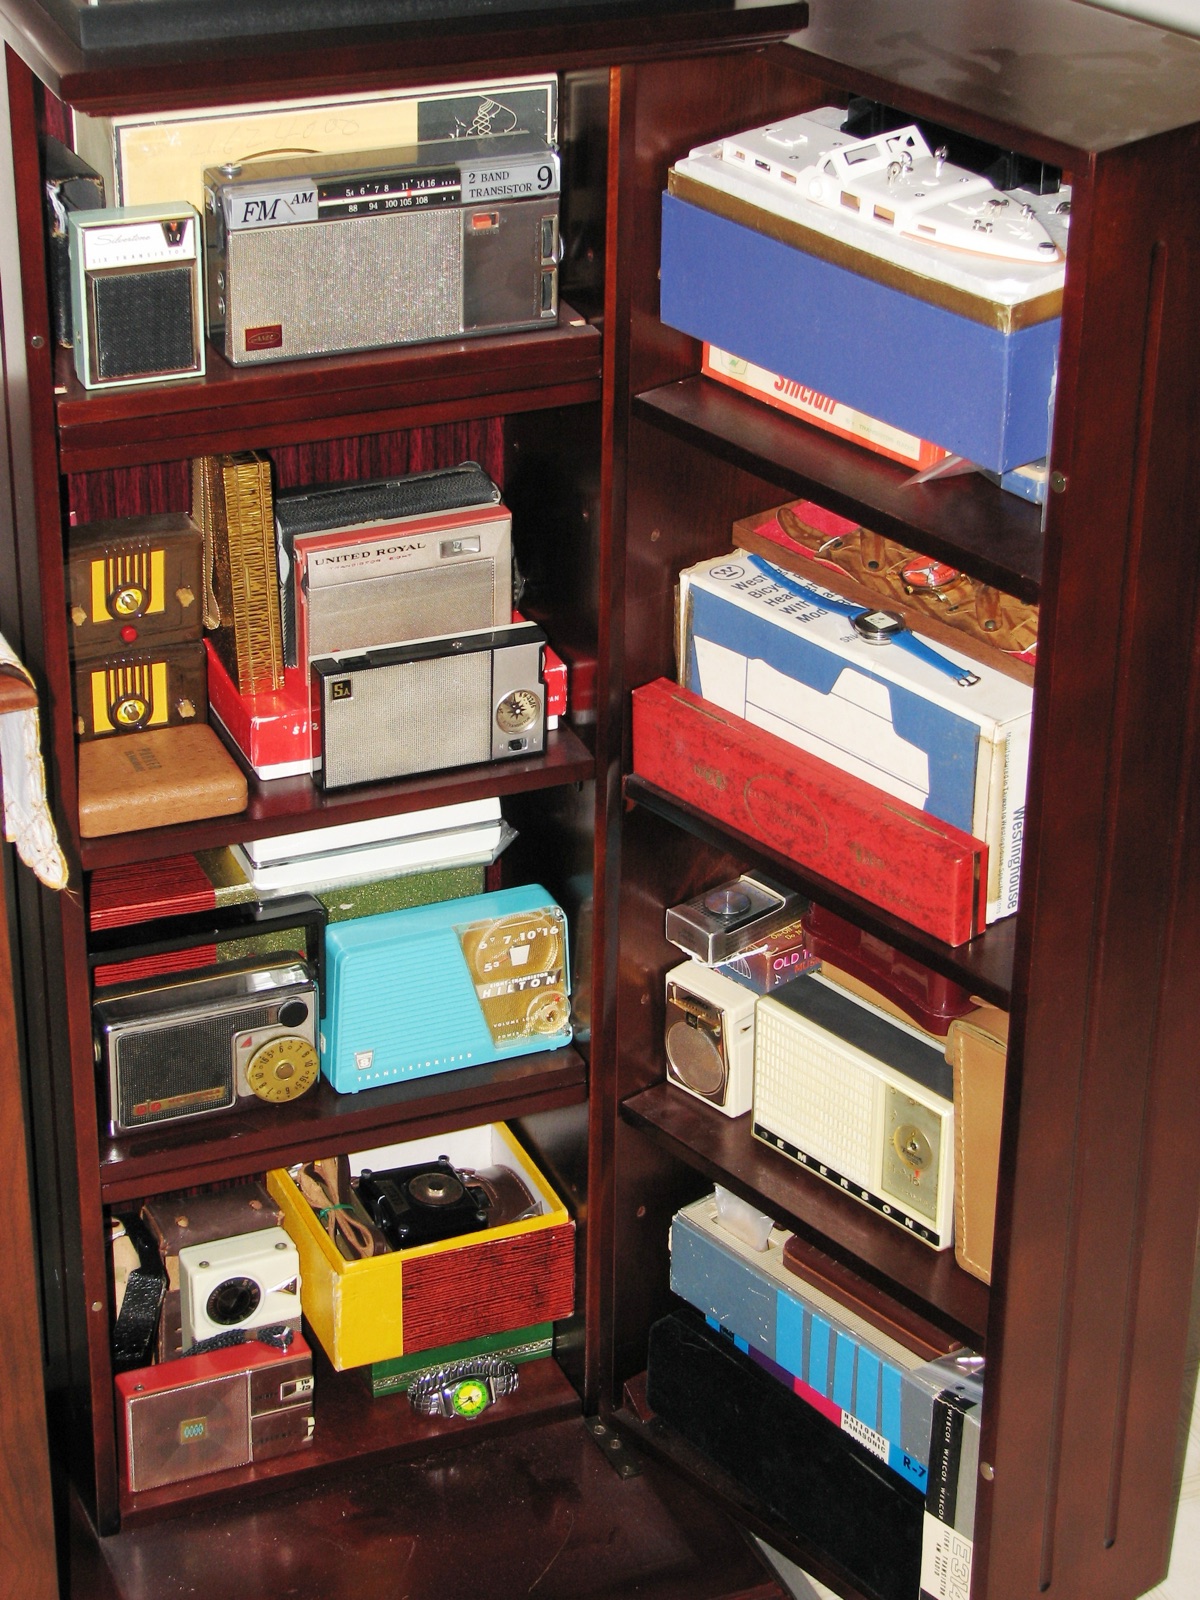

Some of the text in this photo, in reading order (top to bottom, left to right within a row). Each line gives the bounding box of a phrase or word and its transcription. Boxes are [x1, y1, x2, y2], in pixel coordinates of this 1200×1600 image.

[360, 187, 365, 195] 6
[375, 185, 380, 193] 7
[384, 184, 389, 192] 8
[401, 182, 409, 190] 11
[416, 180, 425, 188] 14
[427, 179, 436, 187] 16
[468, 171, 510, 184] 2 BAND
[537, 165, 553, 190] 9
[469, 183, 532, 198] TRANSISTOR
[241, 192, 314, 222] FM AM
[348, 195, 428, 213] 88 94 100 105 108
[116, 249, 188, 261] TRANSISTOR
[315, 543, 427, 566] UNITED ROYAL
[329, 558, 381, 570] TRANSISTOR
[1007, 805, 1025, 909] Westinghouse
[479, 925, 559, 950] 6 7 10 16
[773, 952, 800, 970] OLD
[482, 975, 557, 999] HILTON
[358, 1053, 472, 1082] TRANSISTORIZED
[776, 1138, 914, 1229] EMERSON
[843, 1420, 886, 1453] PANASONIC
[844, 1412, 886, 1447] NATIONAL
[903, 1455, 926, 1478] R-7
[940, 1555, 948, 1596] TRANSISTOR
